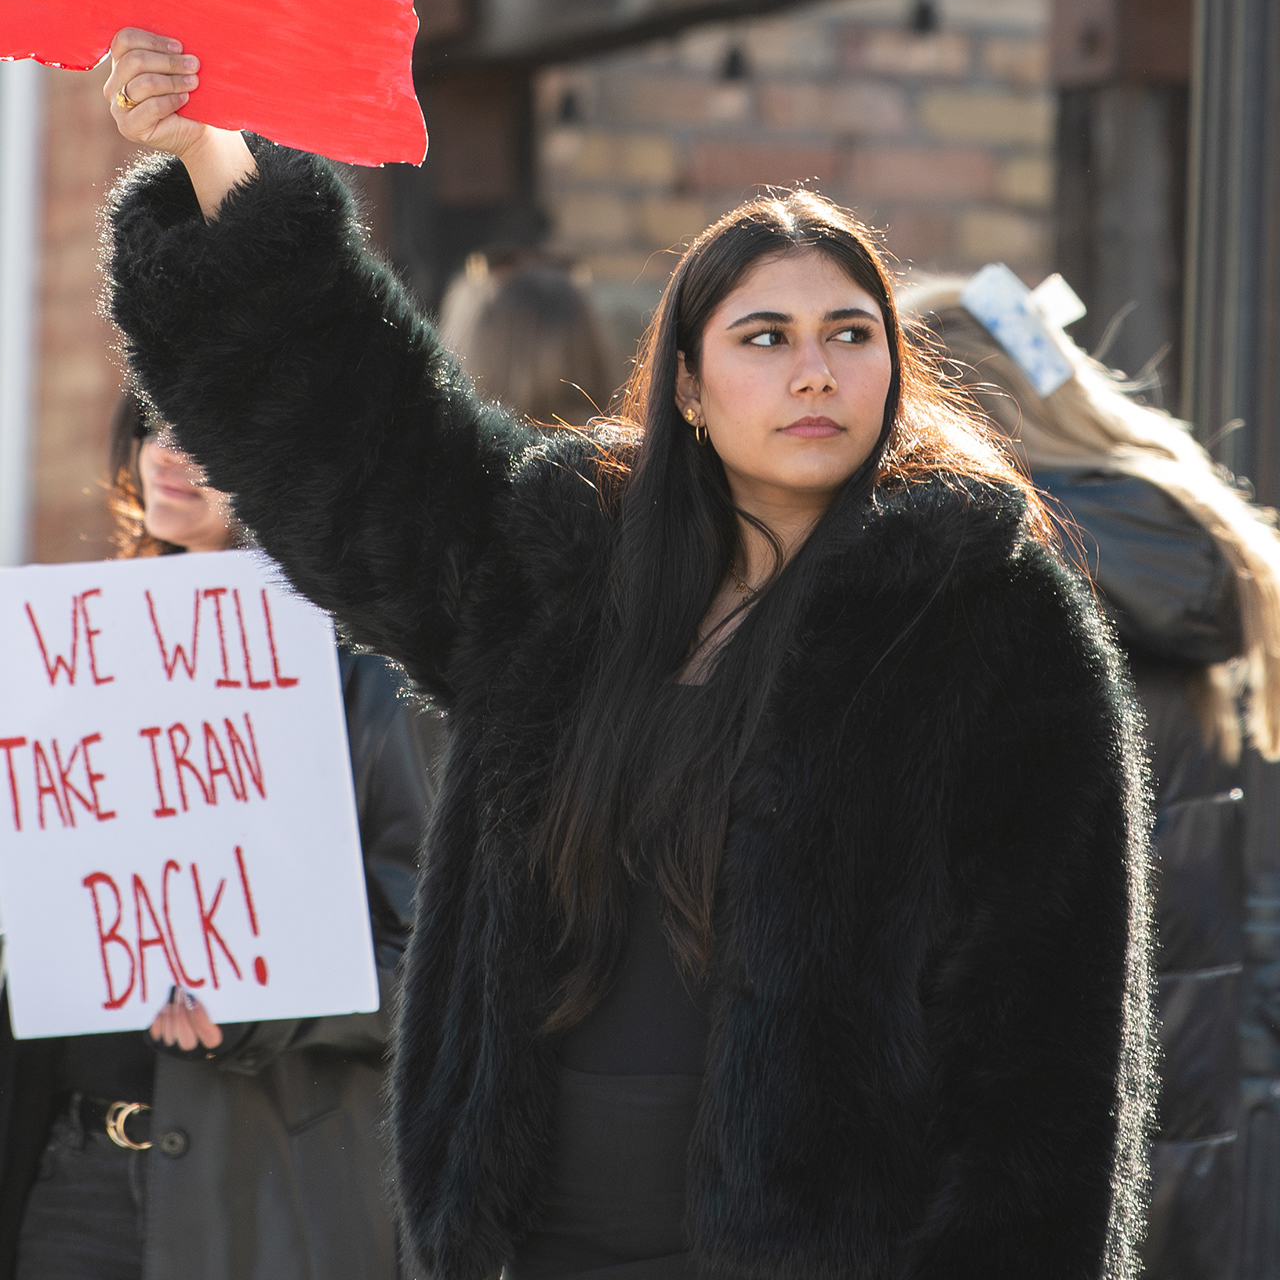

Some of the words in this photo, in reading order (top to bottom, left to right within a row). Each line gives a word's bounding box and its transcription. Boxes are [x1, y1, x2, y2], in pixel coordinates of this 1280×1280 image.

[25, 589, 115, 686] WE
[145, 588, 300, 690] WILL
[139, 713, 267, 819] IRAN
[82, 845, 269, 1010] BACK!
